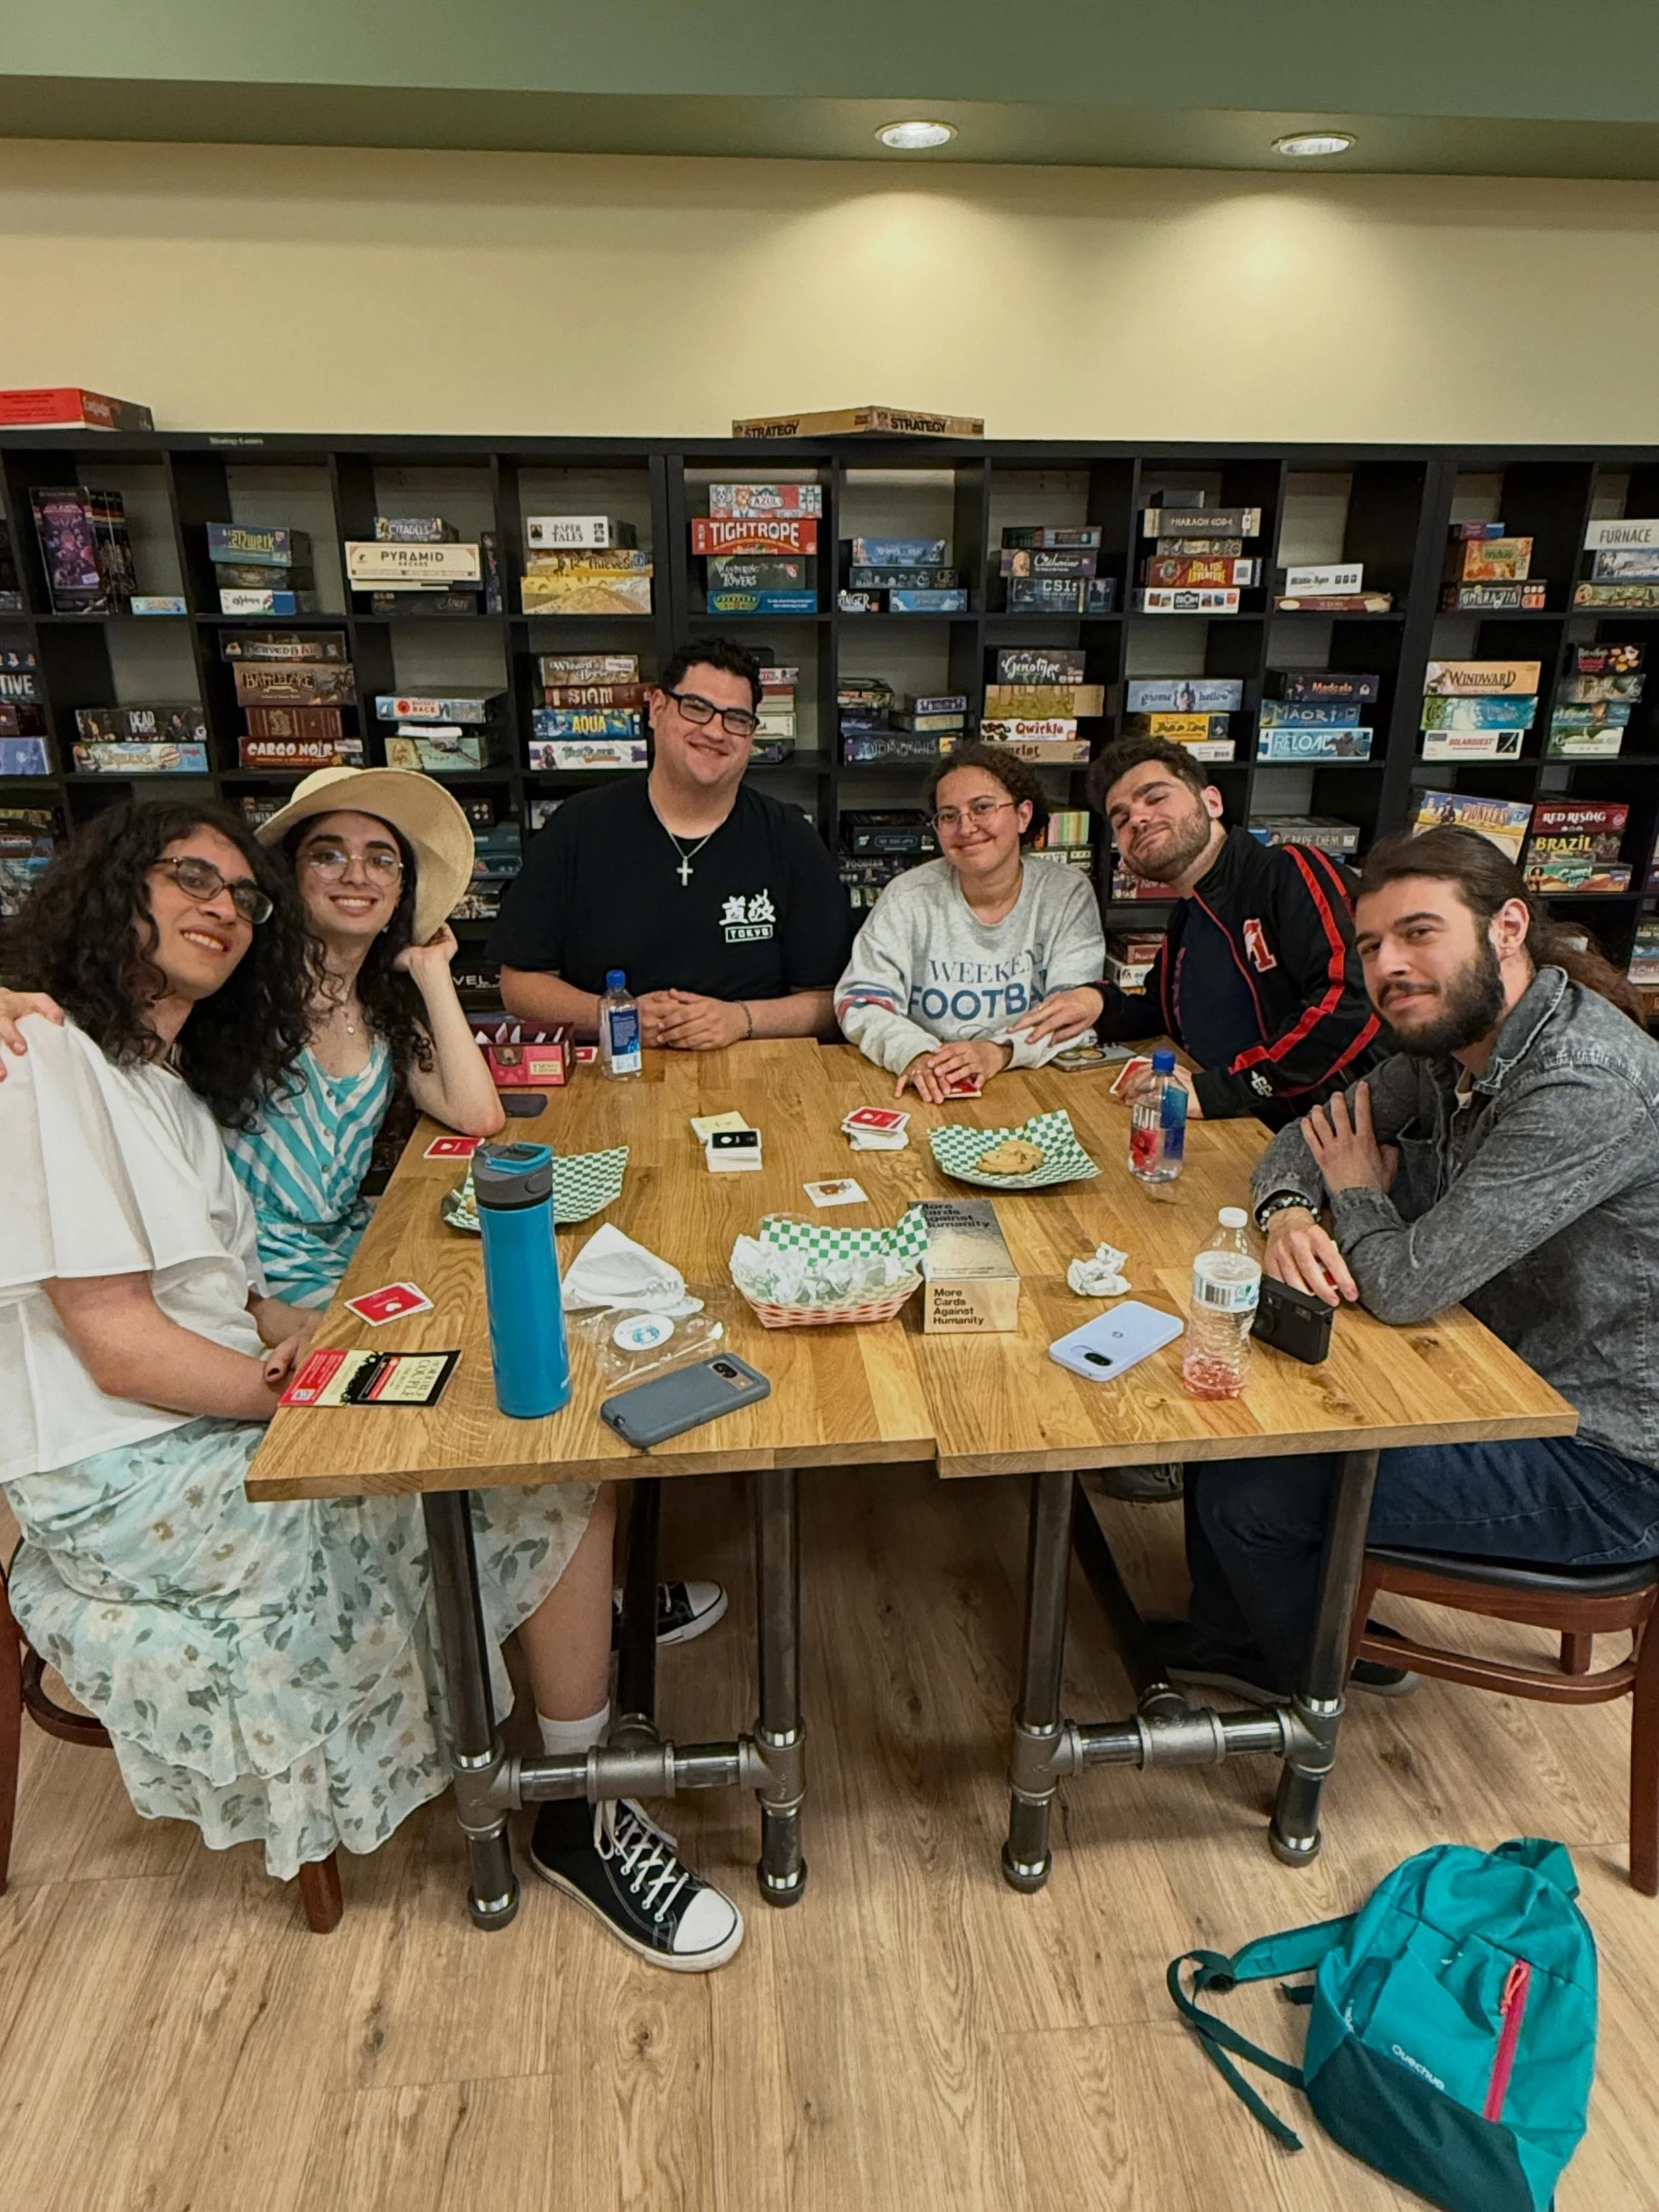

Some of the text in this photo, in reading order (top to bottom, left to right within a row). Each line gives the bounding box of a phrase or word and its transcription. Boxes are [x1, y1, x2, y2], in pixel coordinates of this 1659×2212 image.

[891, 417, 946, 433] STRATEGY
[751, 497, 780, 506] AZUL
[1170, 518, 1209, 526] PHARAOH
[388, 524, 429, 536] CITADELS
[551, 531, 584, 542] TALES
[709, 522, 800, 548] TIGHTROPE
[1599, 528, 1652, 543] FURNACE
[380, 550, 445, 563] PYRAMID
[1448, 668, 1517, 690] WINDWARD
[568, 687, 614, 706] SIAM
[1140, 694, 1172, 707] gnome
[1198, 690, 1229, 702] hollow
[571, 714, 607, 735] AQUA
[247, 743, 293, 757] CARGO
[1542, 811, 1607, 824] RED RISING
[1535, 834, 1592, 851] BRAZIL
[730, 928, 769, 938] TOKYO
[934, 1288, 962, 1297] More
[934, 1297, 966, 1306] Cards
[933, 1307, 974, 1317] Against
[932, 1317, 984, 1326] Humanity
